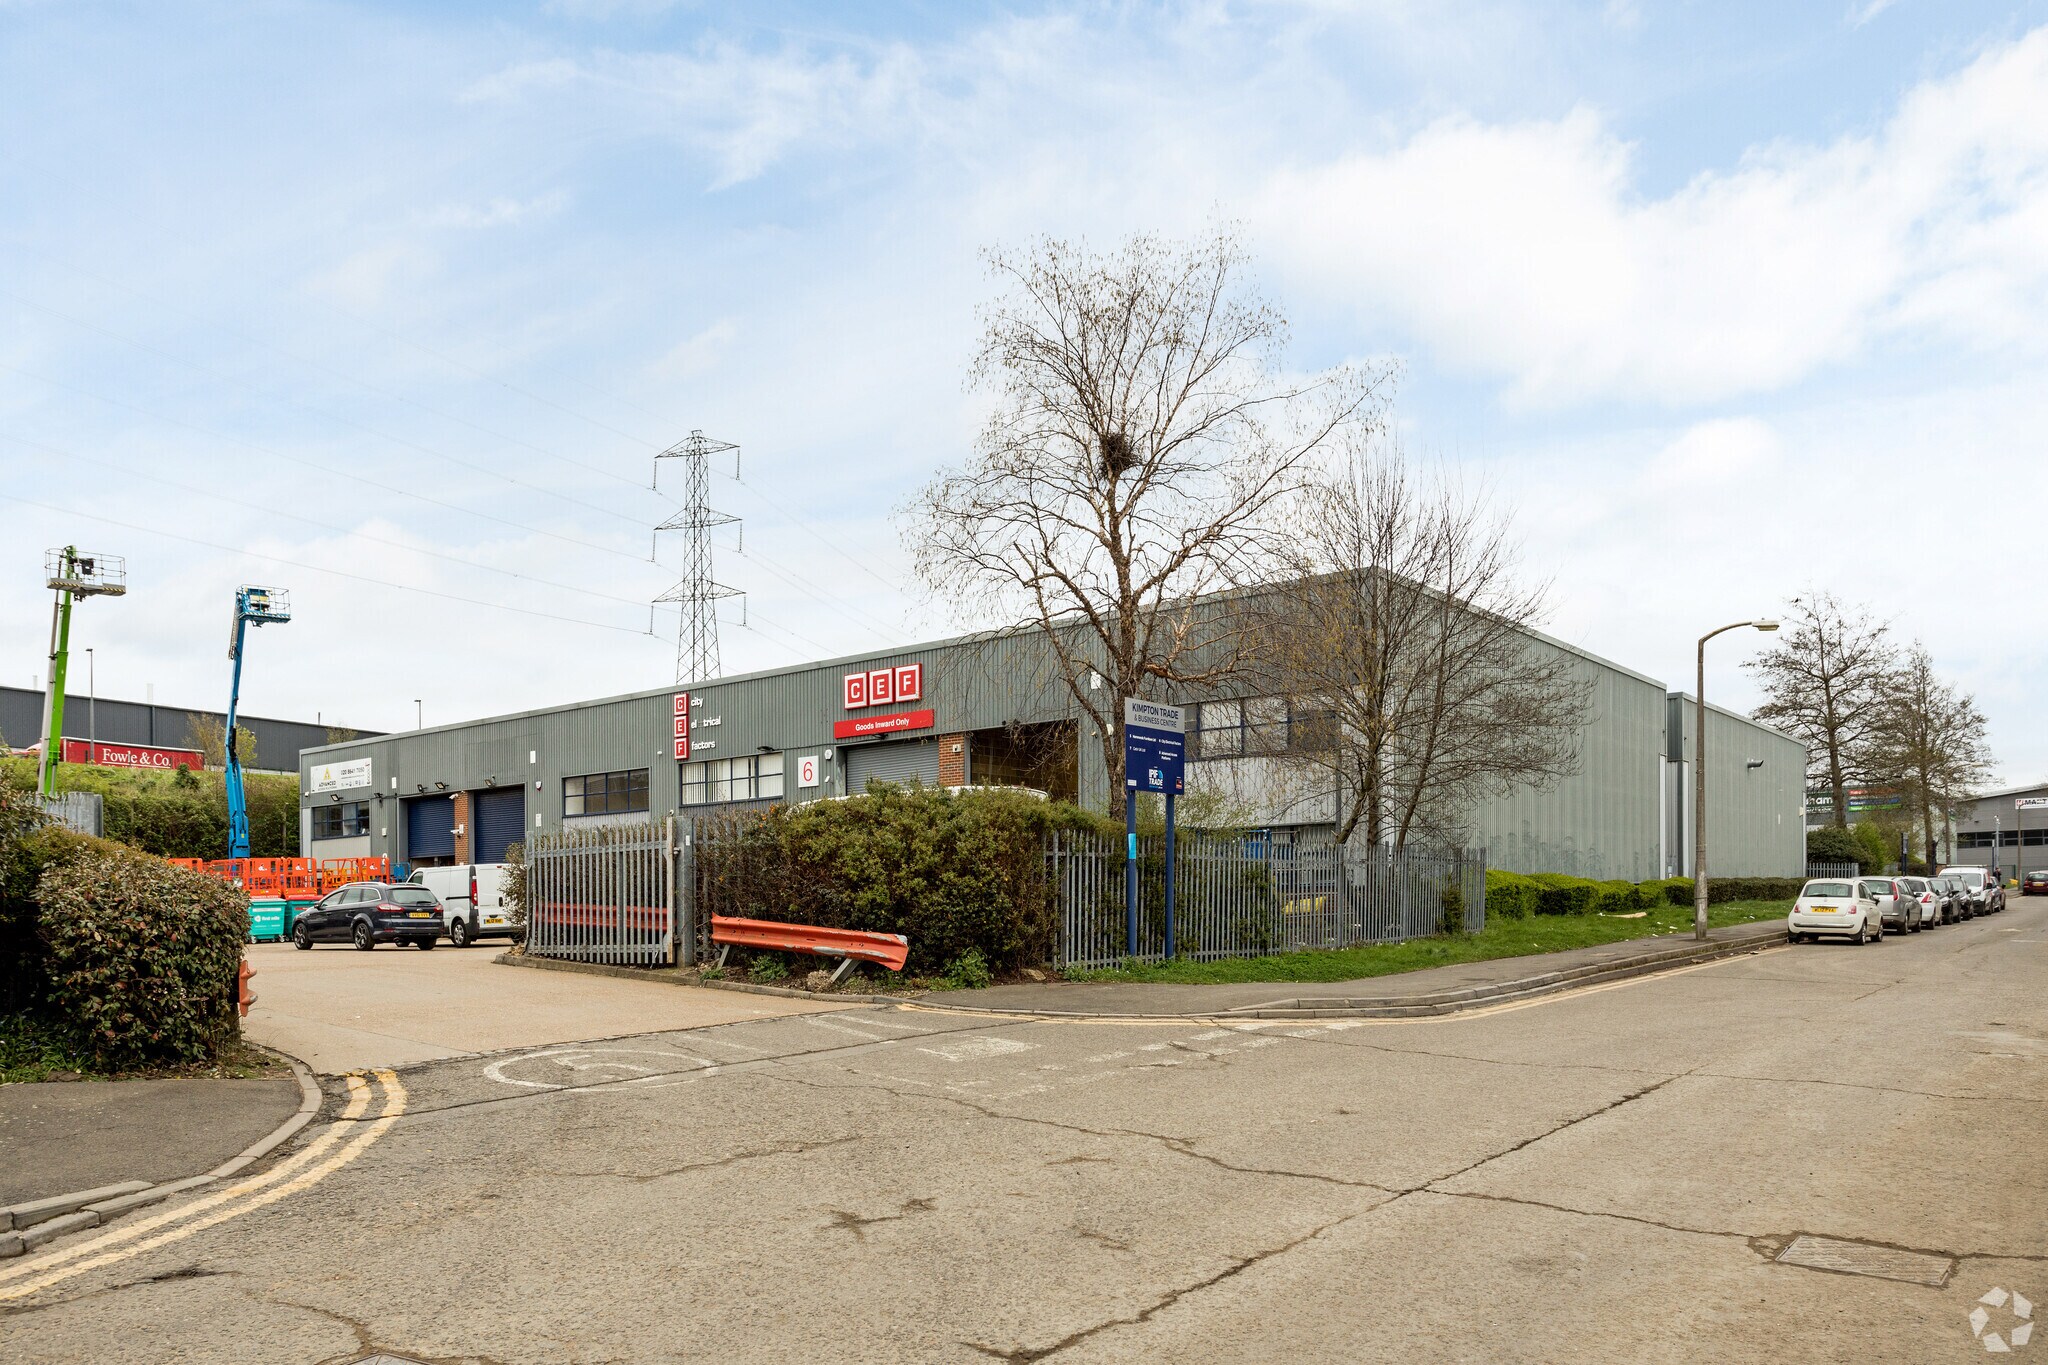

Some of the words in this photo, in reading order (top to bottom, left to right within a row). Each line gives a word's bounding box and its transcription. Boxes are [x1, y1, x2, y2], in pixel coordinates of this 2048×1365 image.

[850, 674, 911, 700] CEF
[690, 696, 704, 708] city
[1132, 703, 1159, 716] KIMPTON
[1160, 708, 1179, 719] TRADE
[690, 715, 721, 729] eltrical
[855, 721, 874, 732] Goods
[875, 719, 895, 730] Inward
[895, 717, 910, 728] Only
[1138, 715, 1160, 726] BUSINESS
[1160, 719, 1177, 728] CENTRE
[691, 739, 716, 751] factors
[103, 748, 137, 763] Fowle
[139, 752, 151, 764] &
[153, 753, 171, 766] Co.
[803, 761, 813, 782] 6
